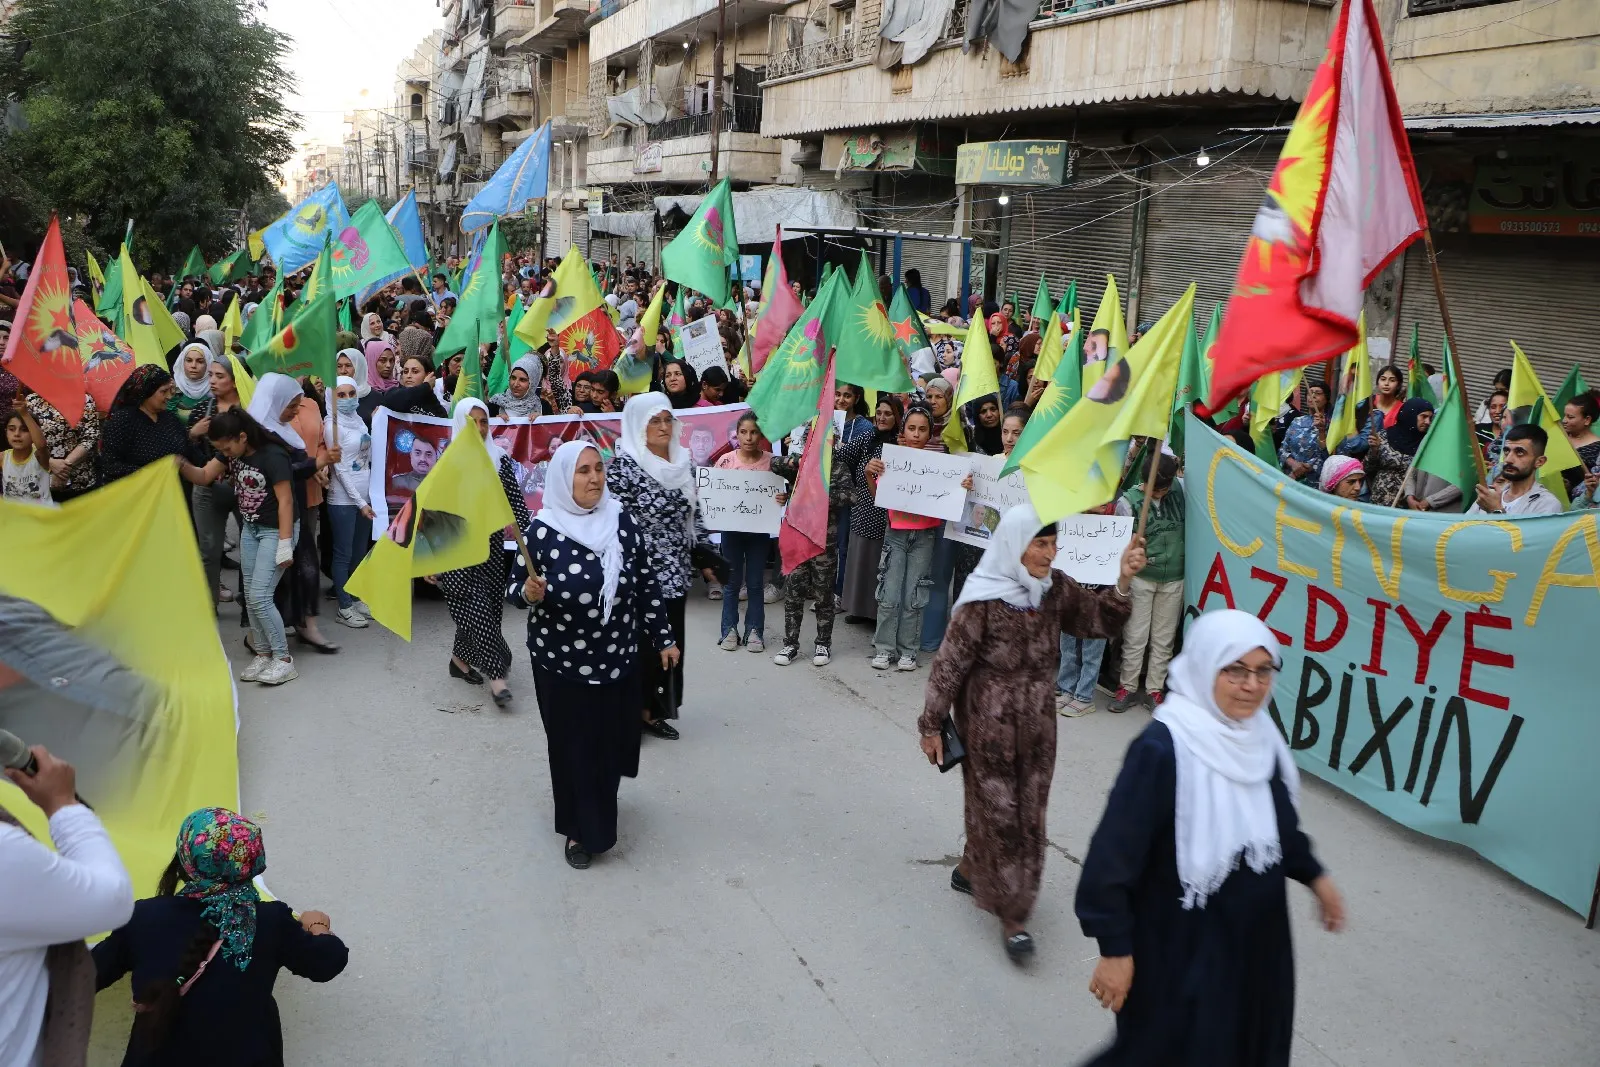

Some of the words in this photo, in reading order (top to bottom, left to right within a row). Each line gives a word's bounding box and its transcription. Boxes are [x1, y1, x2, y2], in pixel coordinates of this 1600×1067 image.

[987, 148, 1024, 176] جوليانا
[1066, 149, 1080, 179] Shoes
[1500, 221, 1560, 232] 0933500573
[1086, 520, 1109, 538] على
[1068, 546, 1092, 564] حياة
